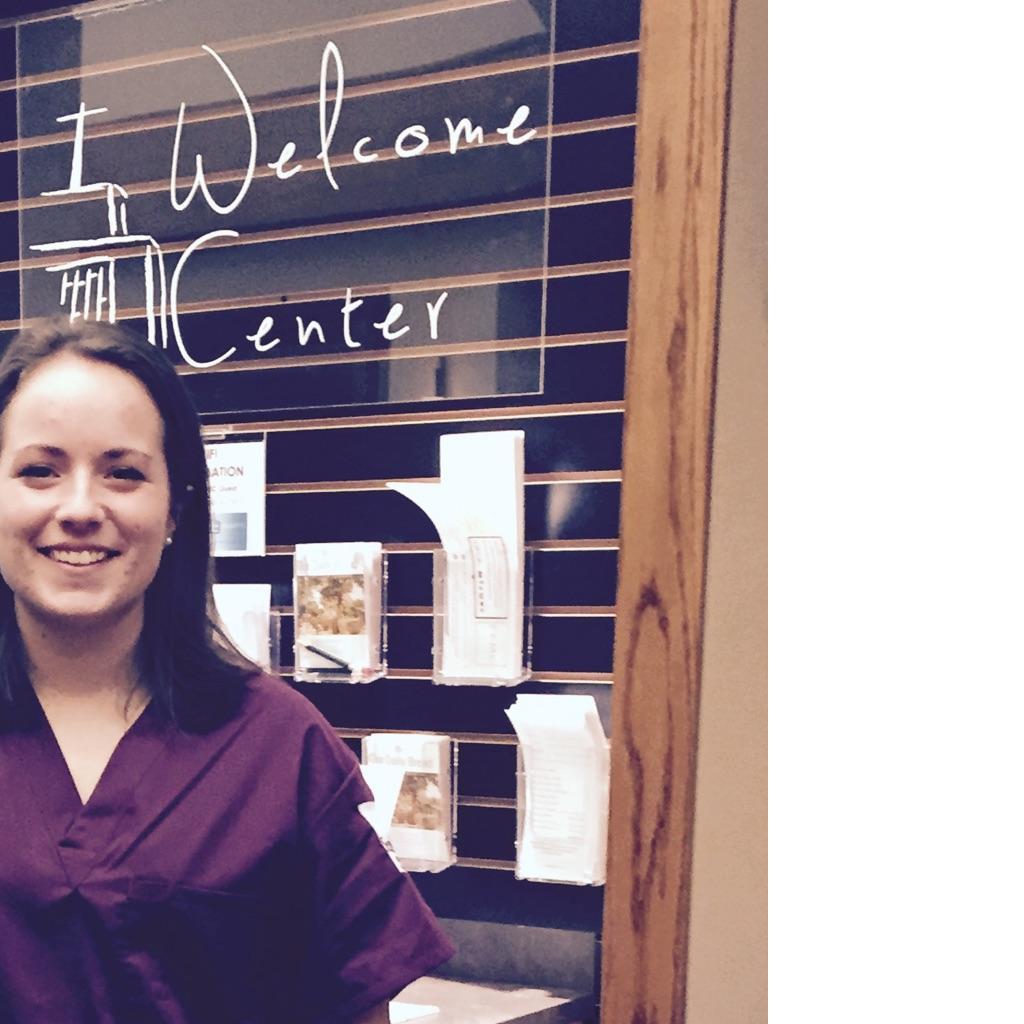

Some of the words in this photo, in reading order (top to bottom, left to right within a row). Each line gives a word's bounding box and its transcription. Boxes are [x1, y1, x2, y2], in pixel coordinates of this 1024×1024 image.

[171, 42, 537, 214] Welcome
[171, 230, 448, 368] Center
[208, 466, 244, 477] ATION
